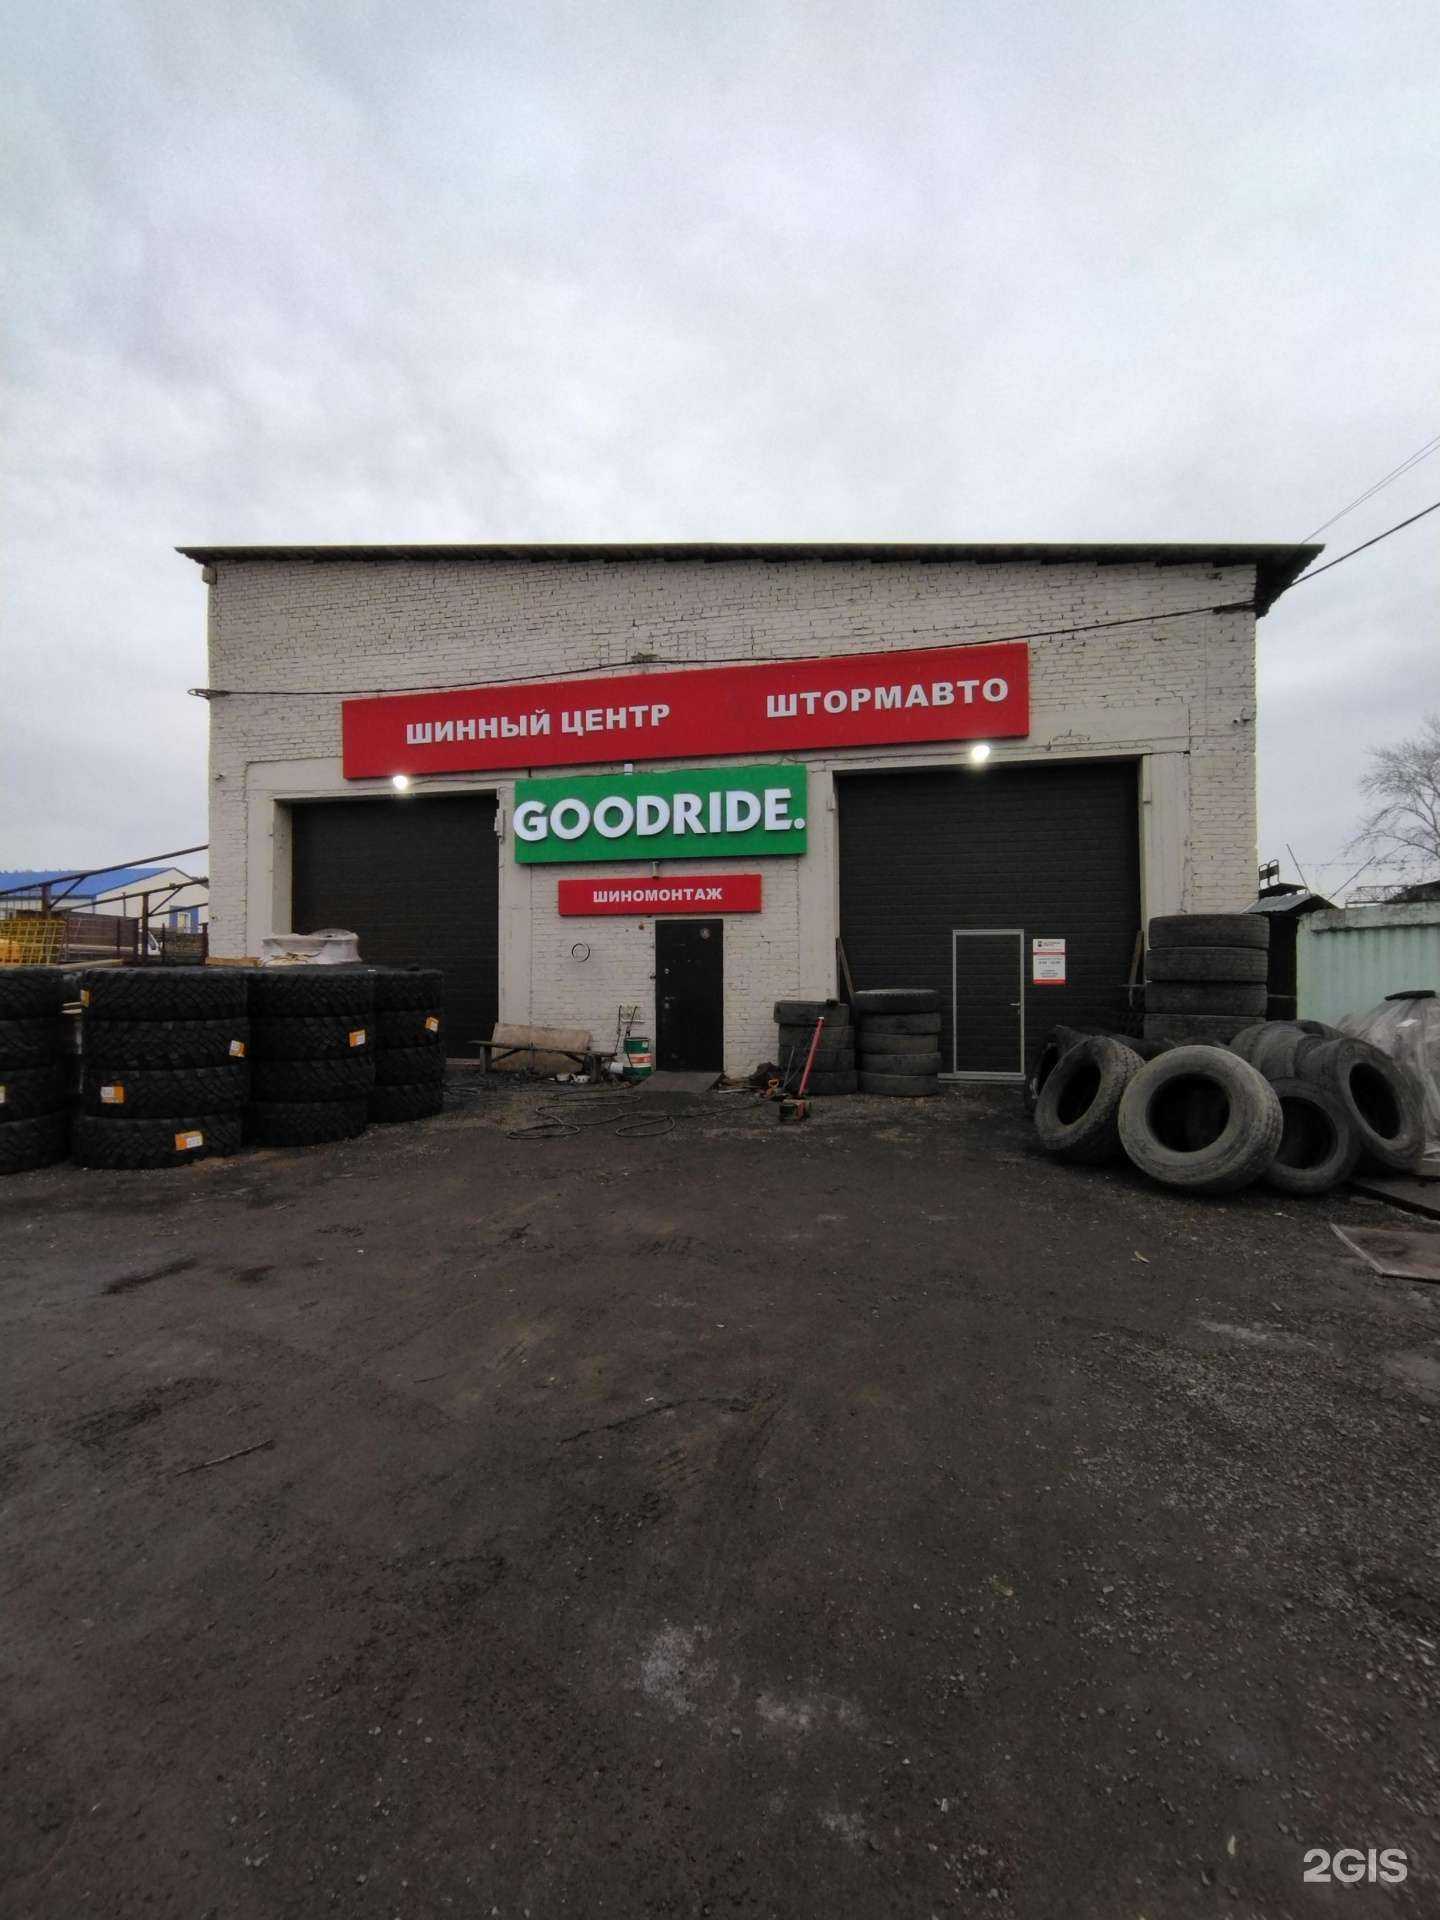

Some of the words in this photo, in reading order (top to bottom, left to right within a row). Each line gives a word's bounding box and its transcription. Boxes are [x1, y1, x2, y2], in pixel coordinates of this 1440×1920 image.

[405, 710, 551, 745] ШИННЫЙ
[561, 704, 671, 737] ЦЕНТР
[766, 678, 1009, 717] ШТОРМАВТО
[513, 788, 805, 842] GOODRIDE.
[592, 887, 723, 903] ШИНОМОНТАЖ
